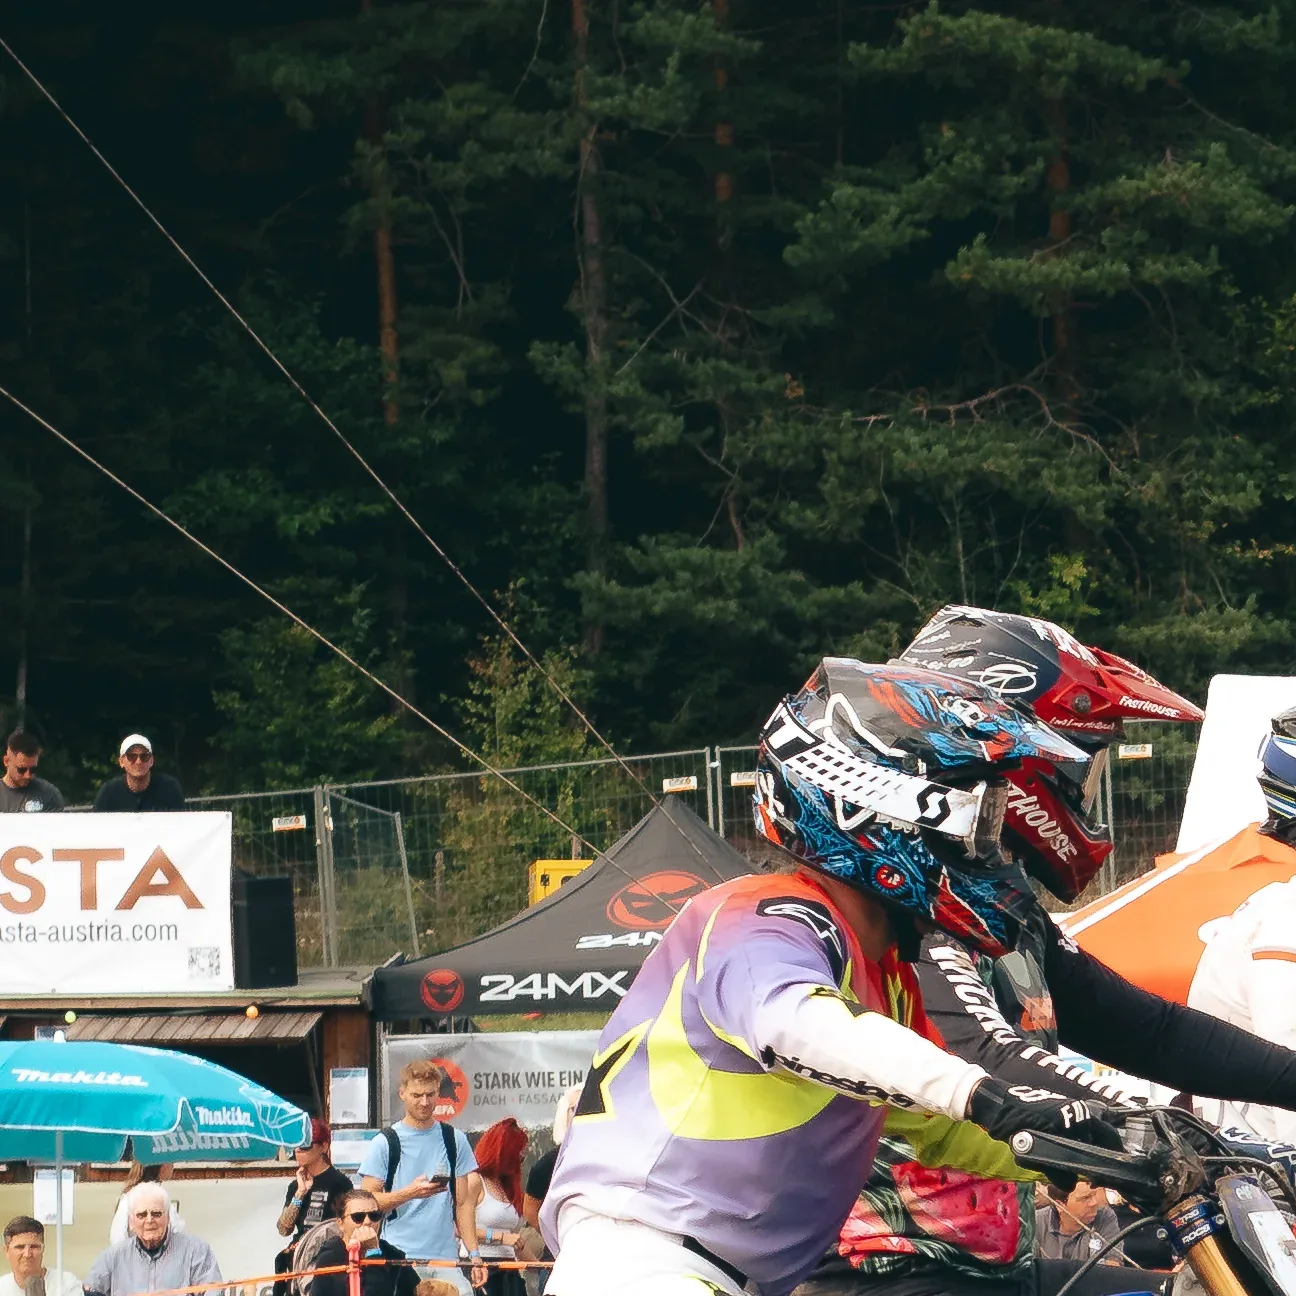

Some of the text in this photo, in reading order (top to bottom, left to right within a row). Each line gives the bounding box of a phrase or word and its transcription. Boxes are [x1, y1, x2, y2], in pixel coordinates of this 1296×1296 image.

[1118, 696, 1180, 718] FASTHOUSE
[1007, 780, 1078, 864] THOUSE
[480, 970, 628, 1002] 24MX
[474, 1070, 583, 1090] STARK WIE EIN
[474, 1092, 564, 1107] DACH FASSA
